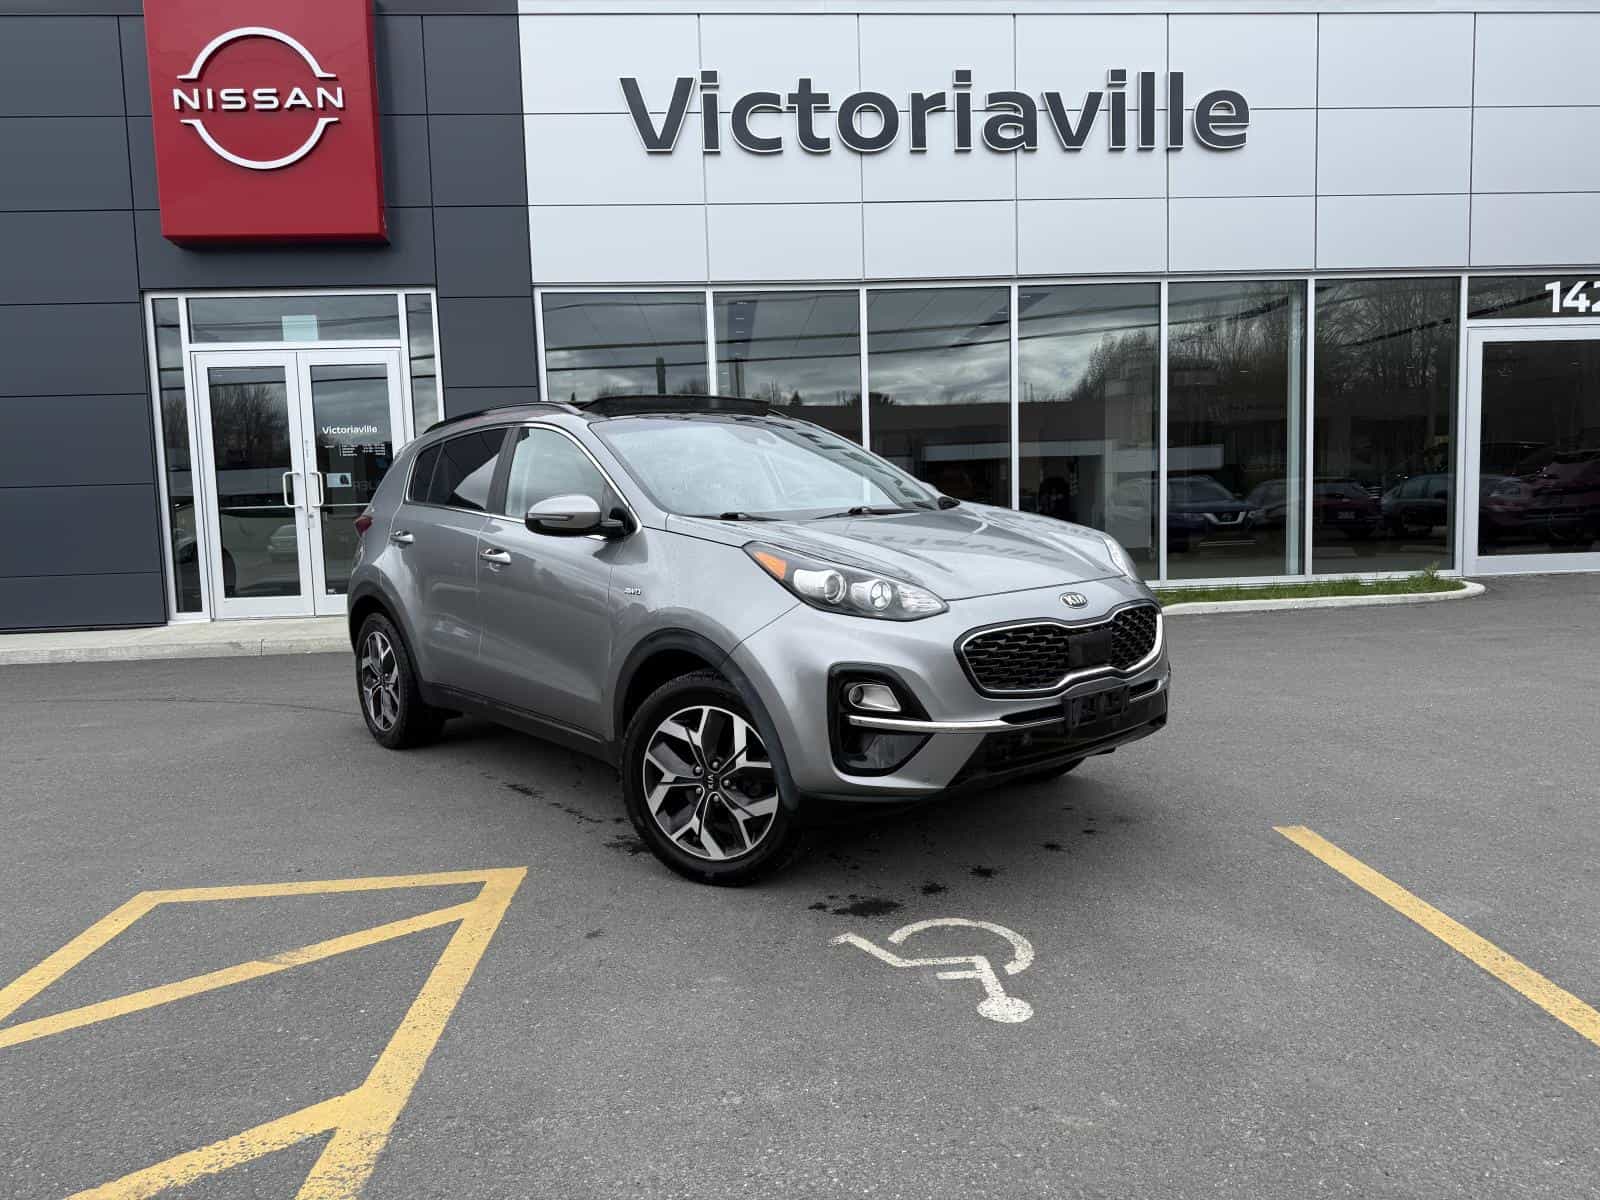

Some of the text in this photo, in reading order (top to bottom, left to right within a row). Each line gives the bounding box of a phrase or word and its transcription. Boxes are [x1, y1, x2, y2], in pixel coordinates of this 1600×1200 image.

[172, 86, 344, 110] NISSAN
[618, 69, 1251, 153] Victoriaville
[322, 425, 378, 434] Victoriaville
